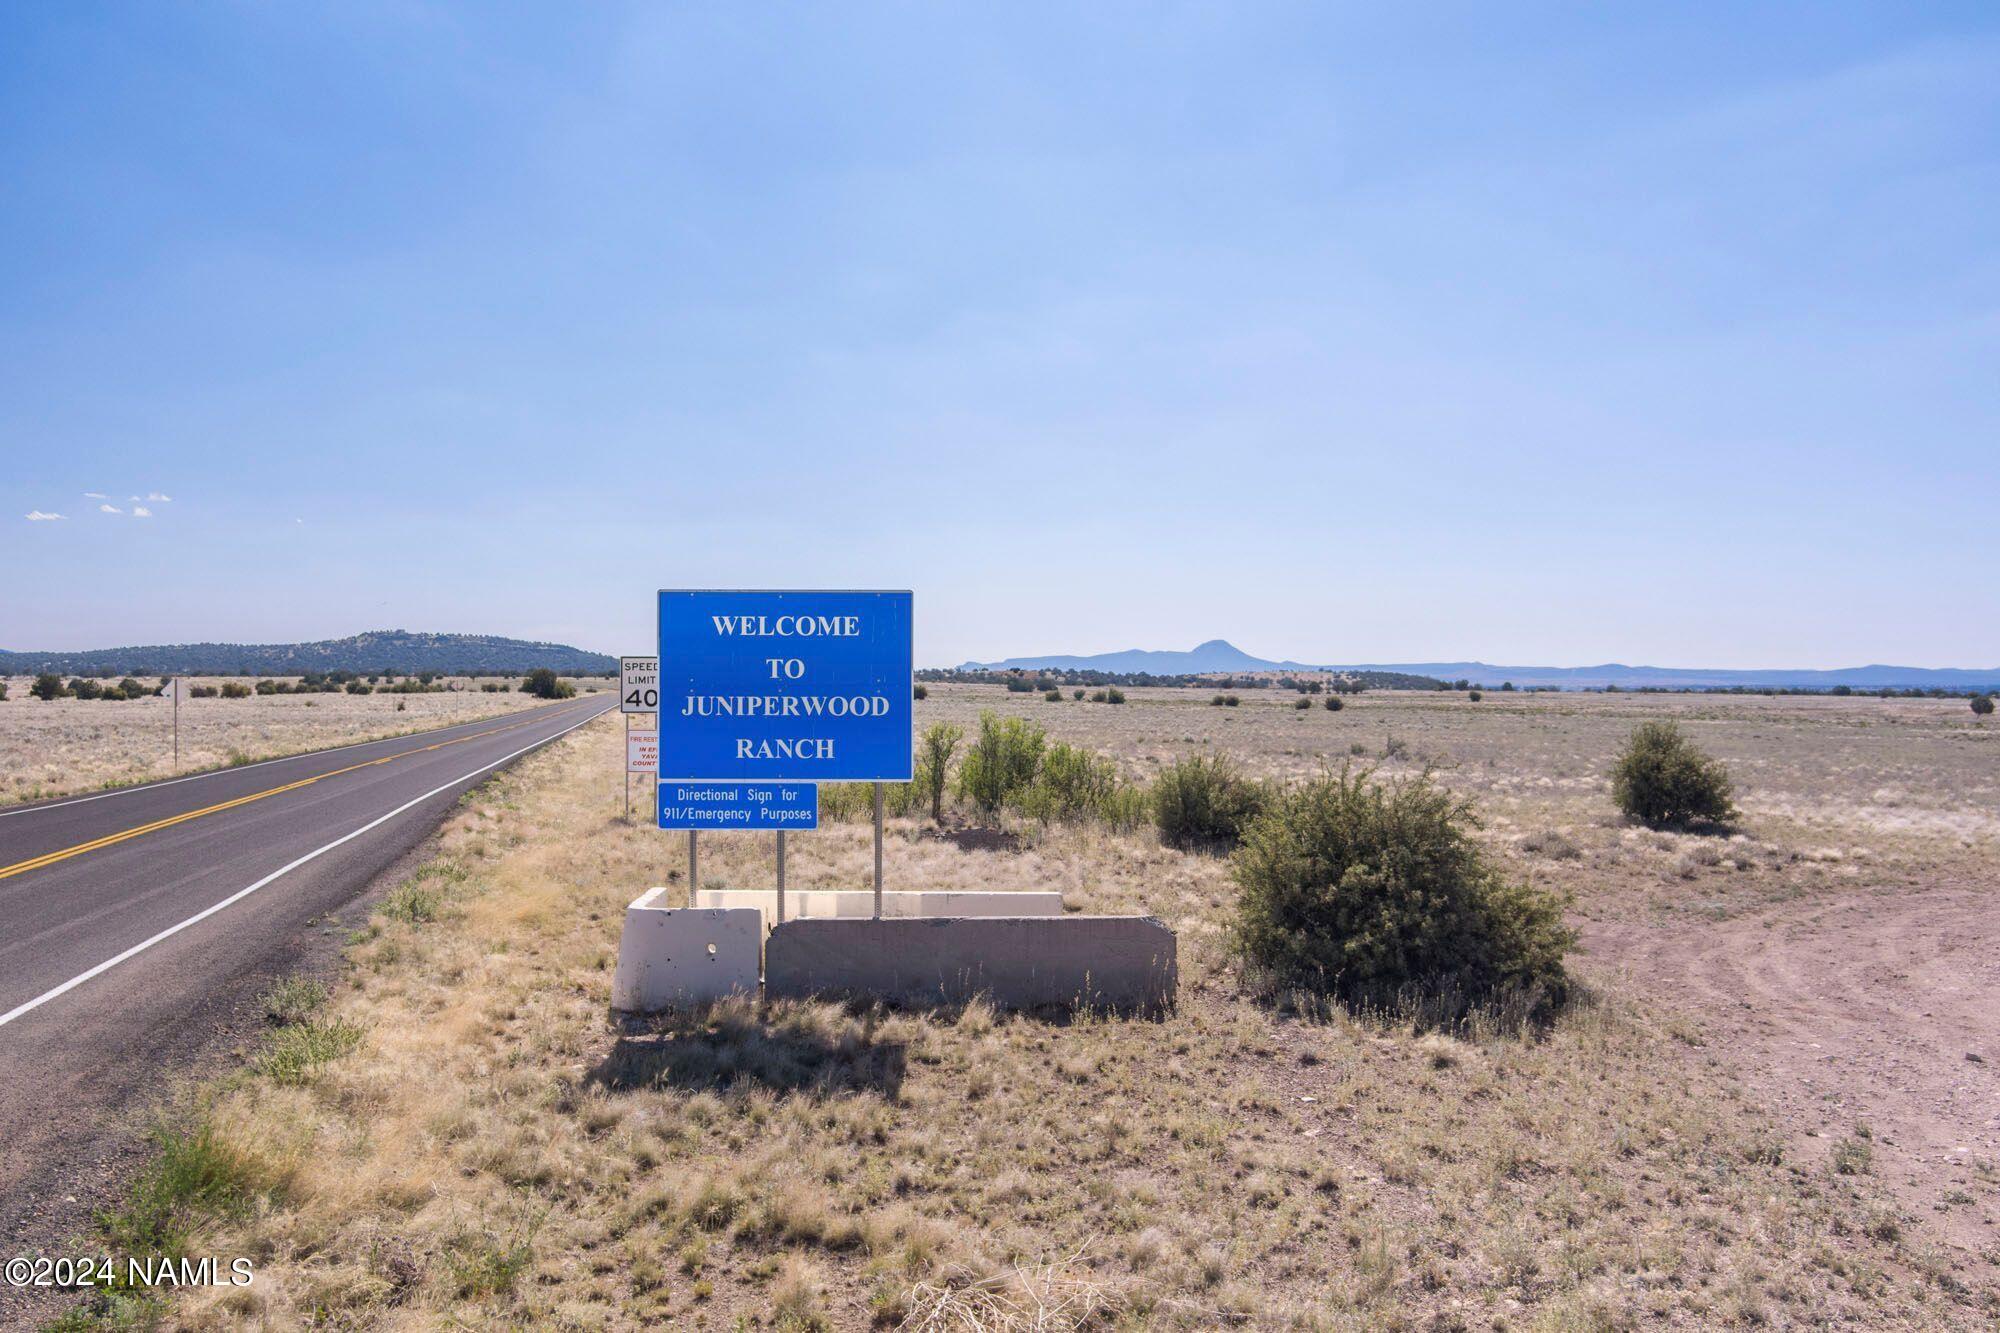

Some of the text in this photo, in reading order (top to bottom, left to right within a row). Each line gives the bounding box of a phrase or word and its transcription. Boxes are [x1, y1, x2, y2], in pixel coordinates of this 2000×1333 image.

[712, 615, 860, 637] WELCOME
[766, 658, 805, 679] TO
[628, 675, 656, 685] LIMIT
[625, 689, 658, 707] 40
[682, 696, 890, 717] JUNIPERWOOD
[736, 738, 835, 759] RANCH
[678, 788, 798, 804] Directional Sign for
[664, 807, 812, 822] 911/Emergency Purposes
